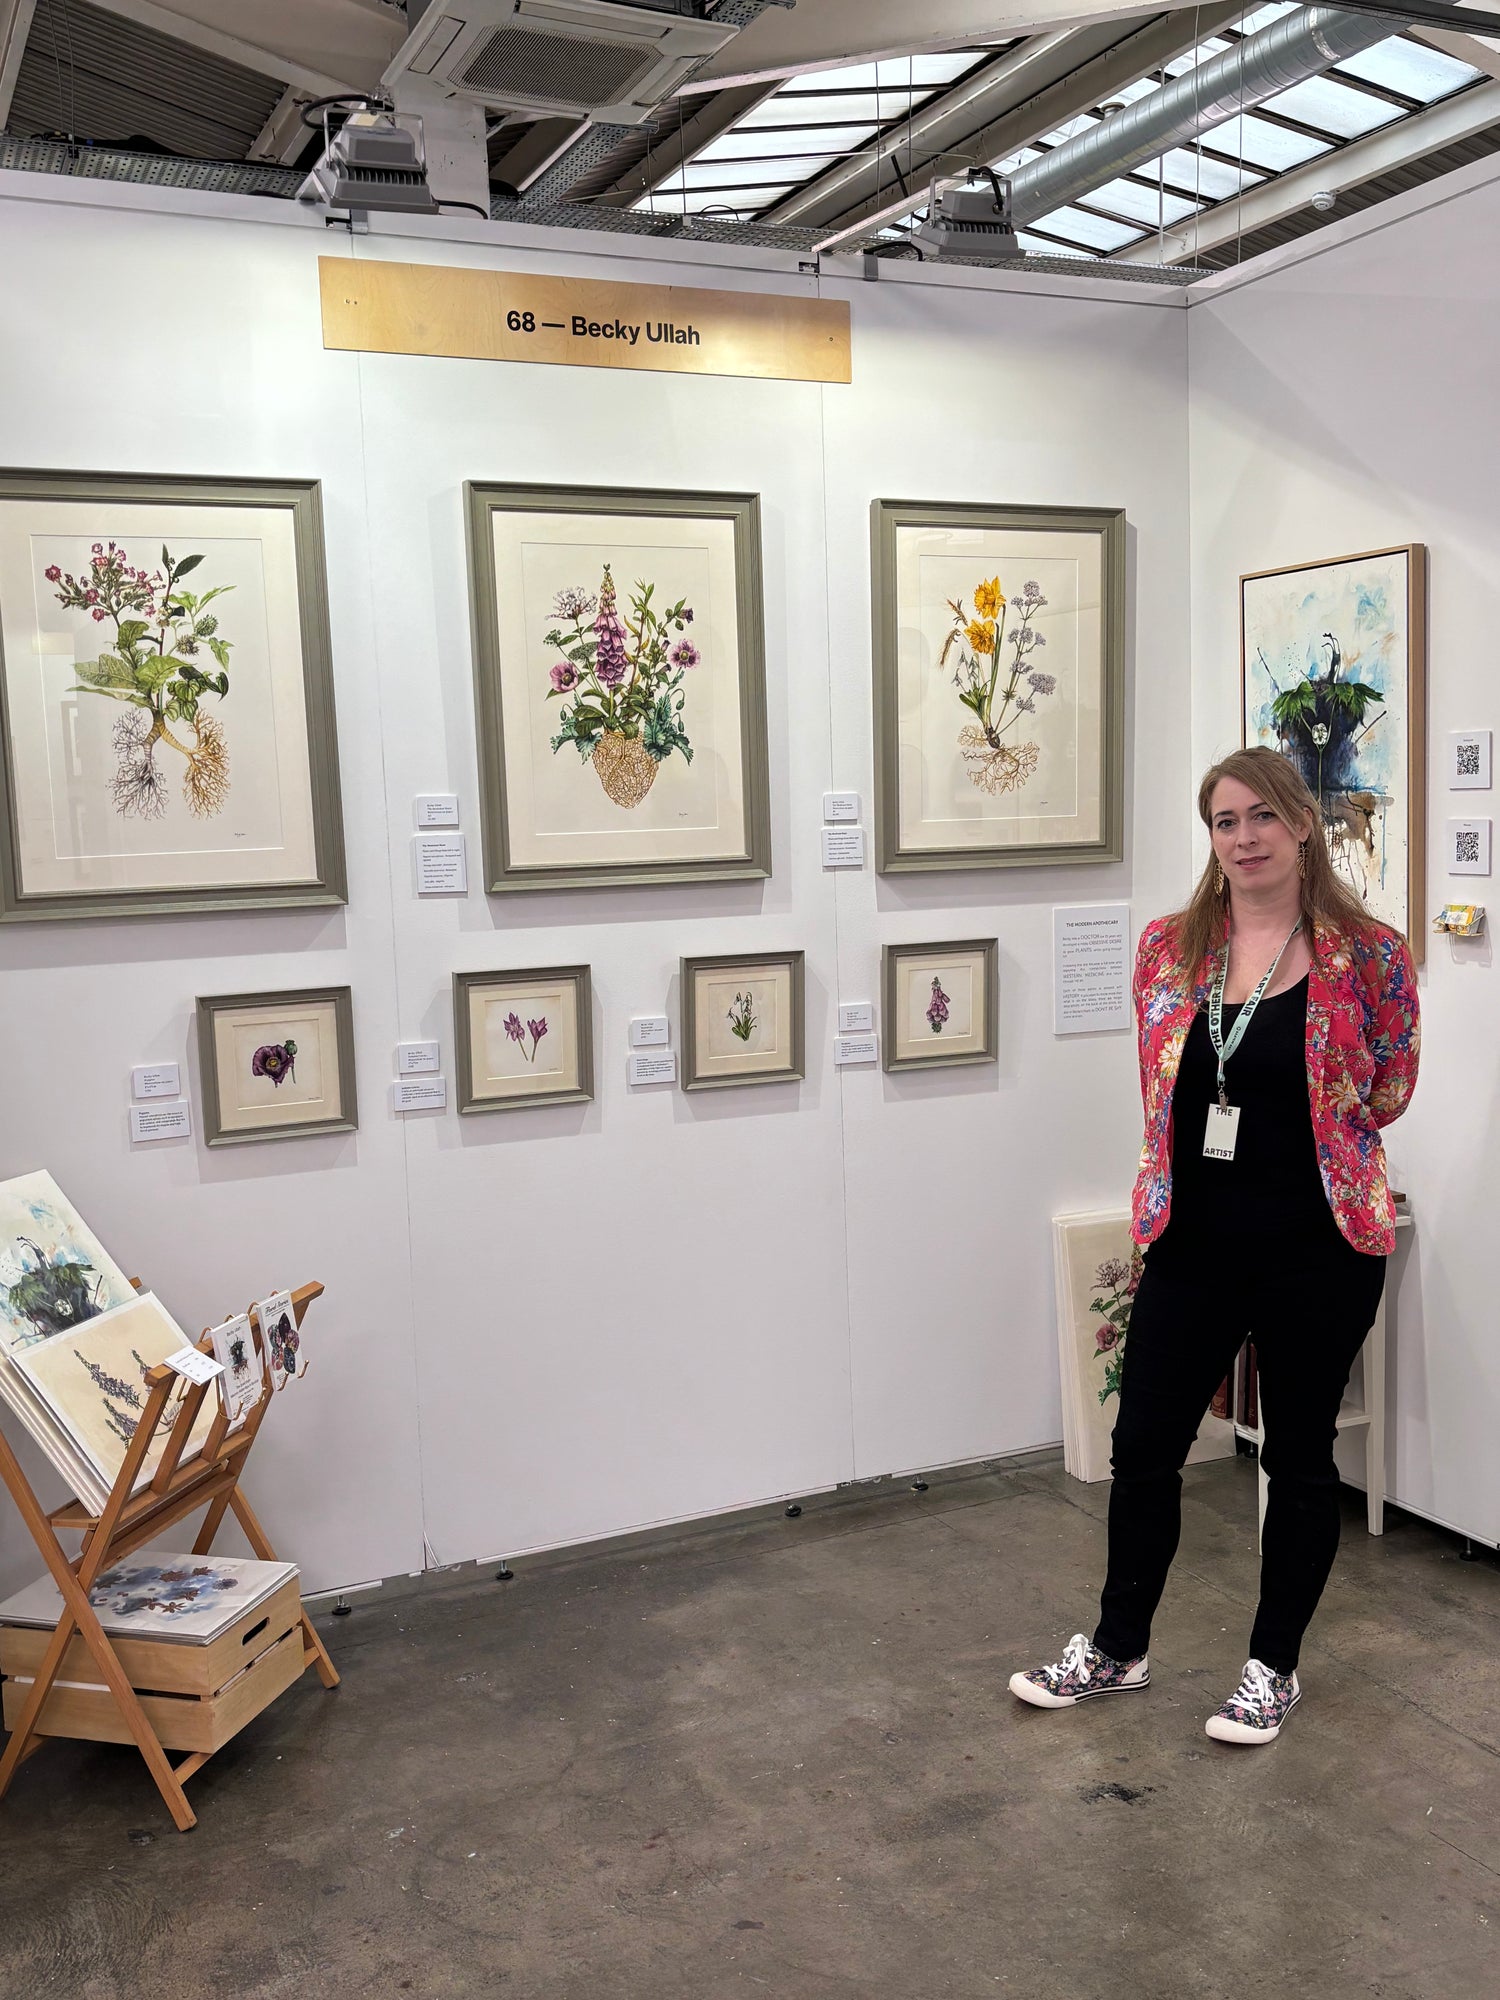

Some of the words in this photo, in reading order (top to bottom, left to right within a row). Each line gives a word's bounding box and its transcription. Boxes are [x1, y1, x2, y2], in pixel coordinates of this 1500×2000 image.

[506, 310, 536, 333] 68
[571, 315, 641, 345] Becky
[646, 321, 701, 345] Ullah
[1213, 974, 1224, 991] ART
[1255, 976, 1269, 995] ART
[1210, 991, 1221, 1027] OTHER
[1240, 995, 1259, 1016] FAIR
[1210, 1028, 1222, 1051] THE
[1215, 1107, 1233, 1117] THE
[1203, 1147, 1234, 1158] ARTIST
